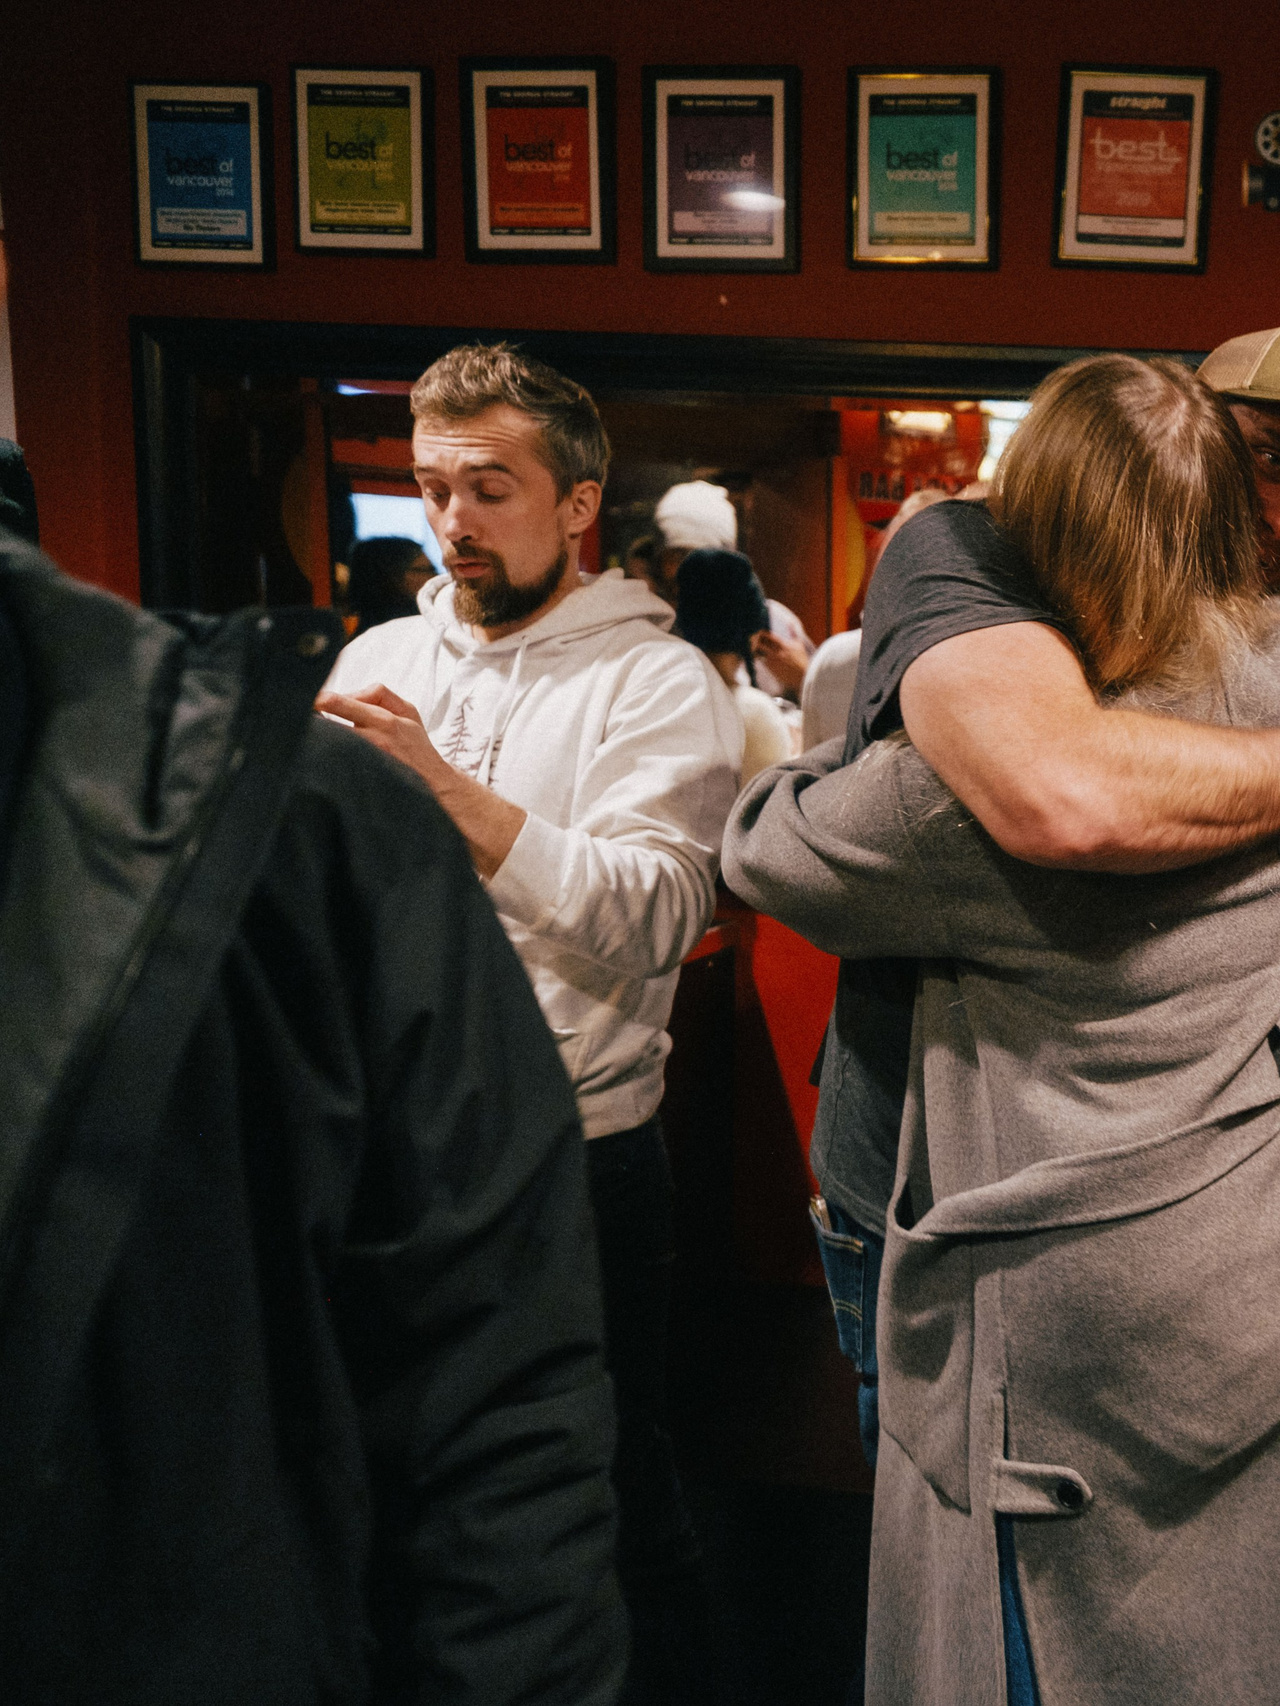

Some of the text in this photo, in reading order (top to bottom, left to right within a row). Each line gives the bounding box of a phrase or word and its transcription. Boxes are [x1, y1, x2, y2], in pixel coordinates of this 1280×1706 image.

[325, 131, 376, 160] best
[504, 134, 555, 162] best
[886, 142, 940, 170] best
[1089, 126, 1182, 163] best
